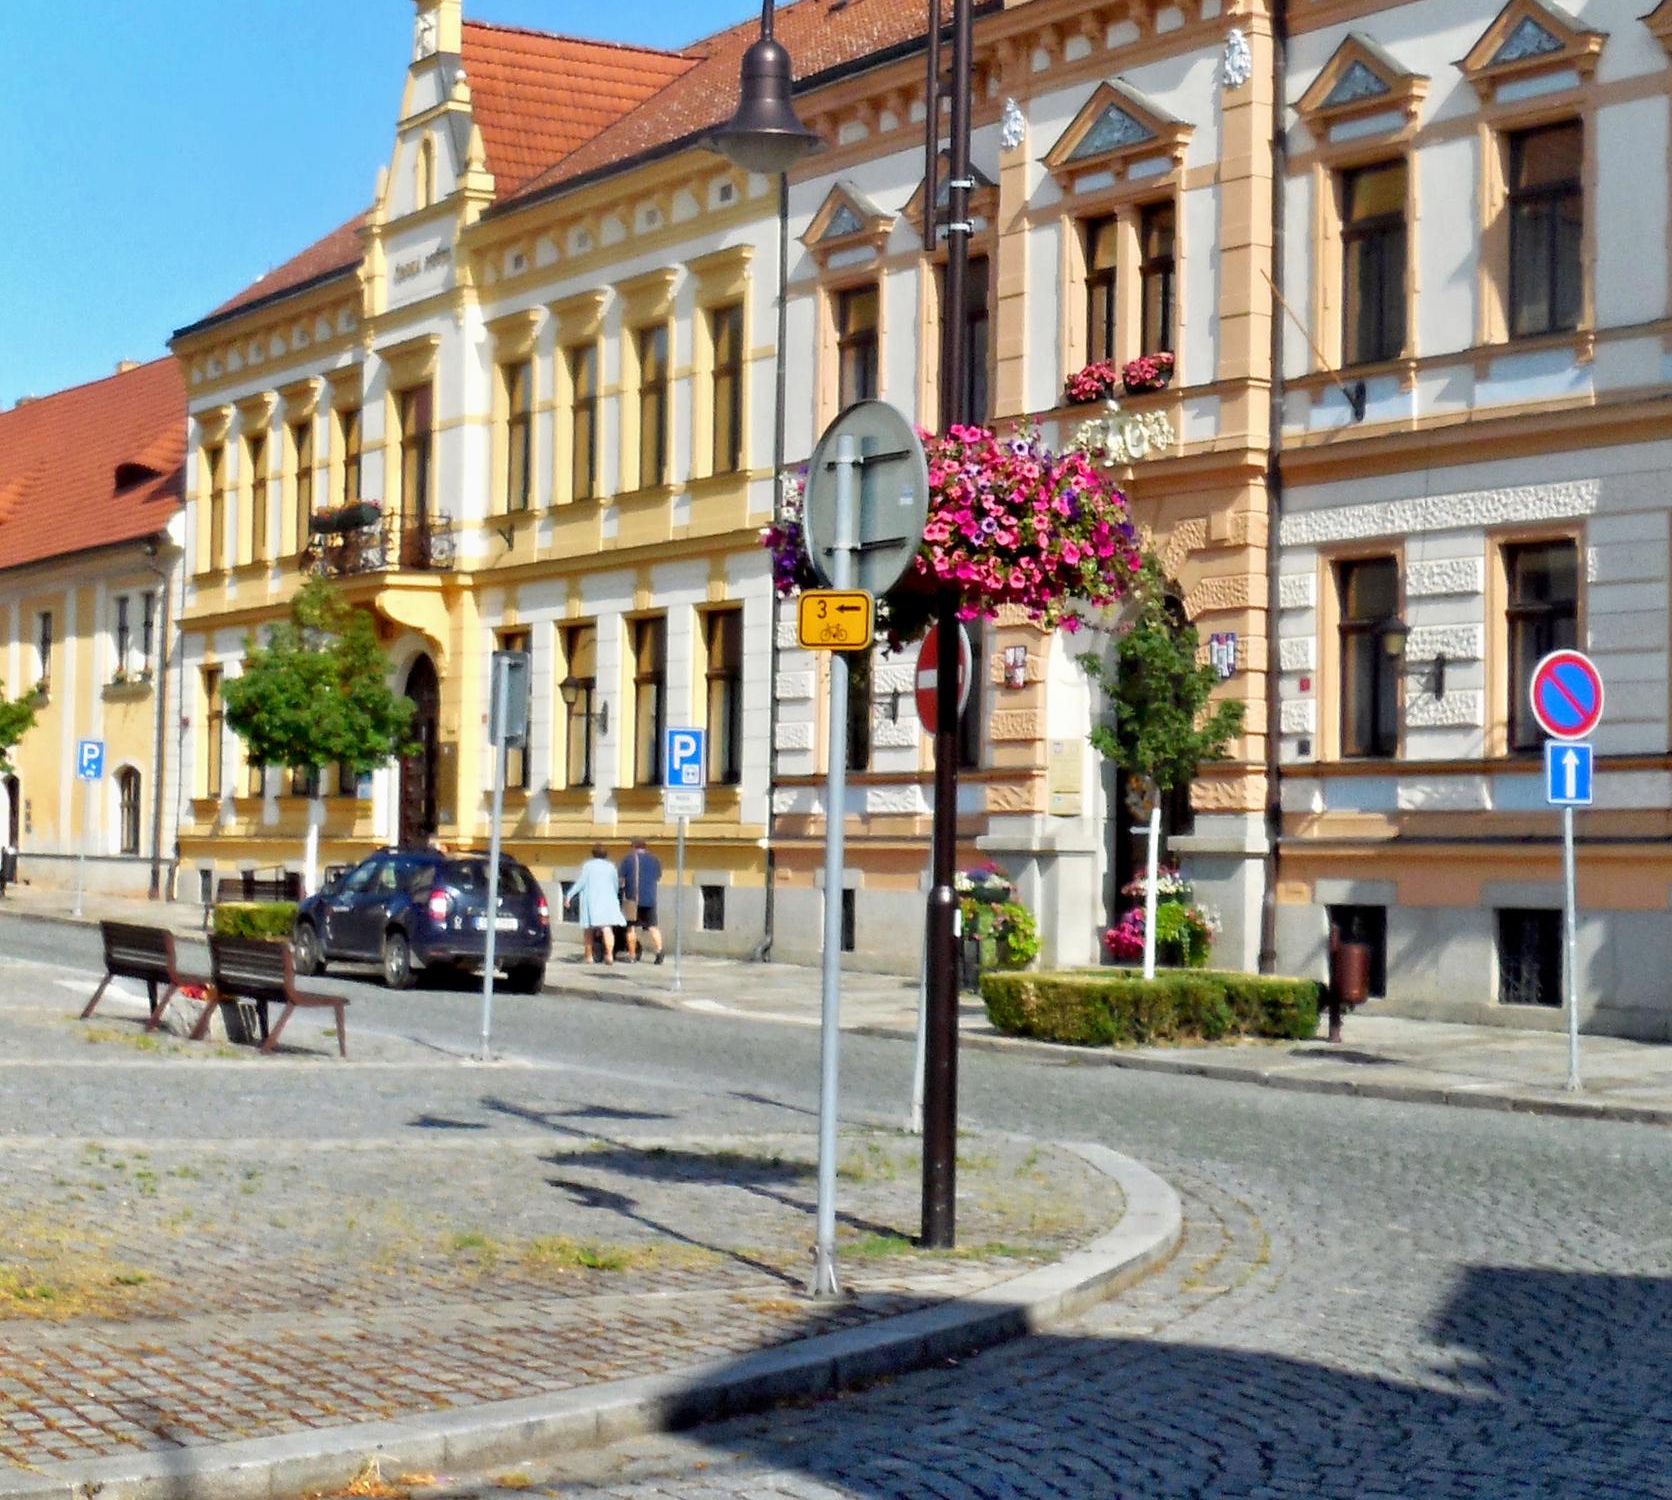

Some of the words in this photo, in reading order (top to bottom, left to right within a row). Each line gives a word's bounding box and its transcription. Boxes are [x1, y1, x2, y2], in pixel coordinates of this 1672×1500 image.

[817, 599, 828, 619] 3
[83, 743, 100, 767] P
[673, 734, 696, 770] P
